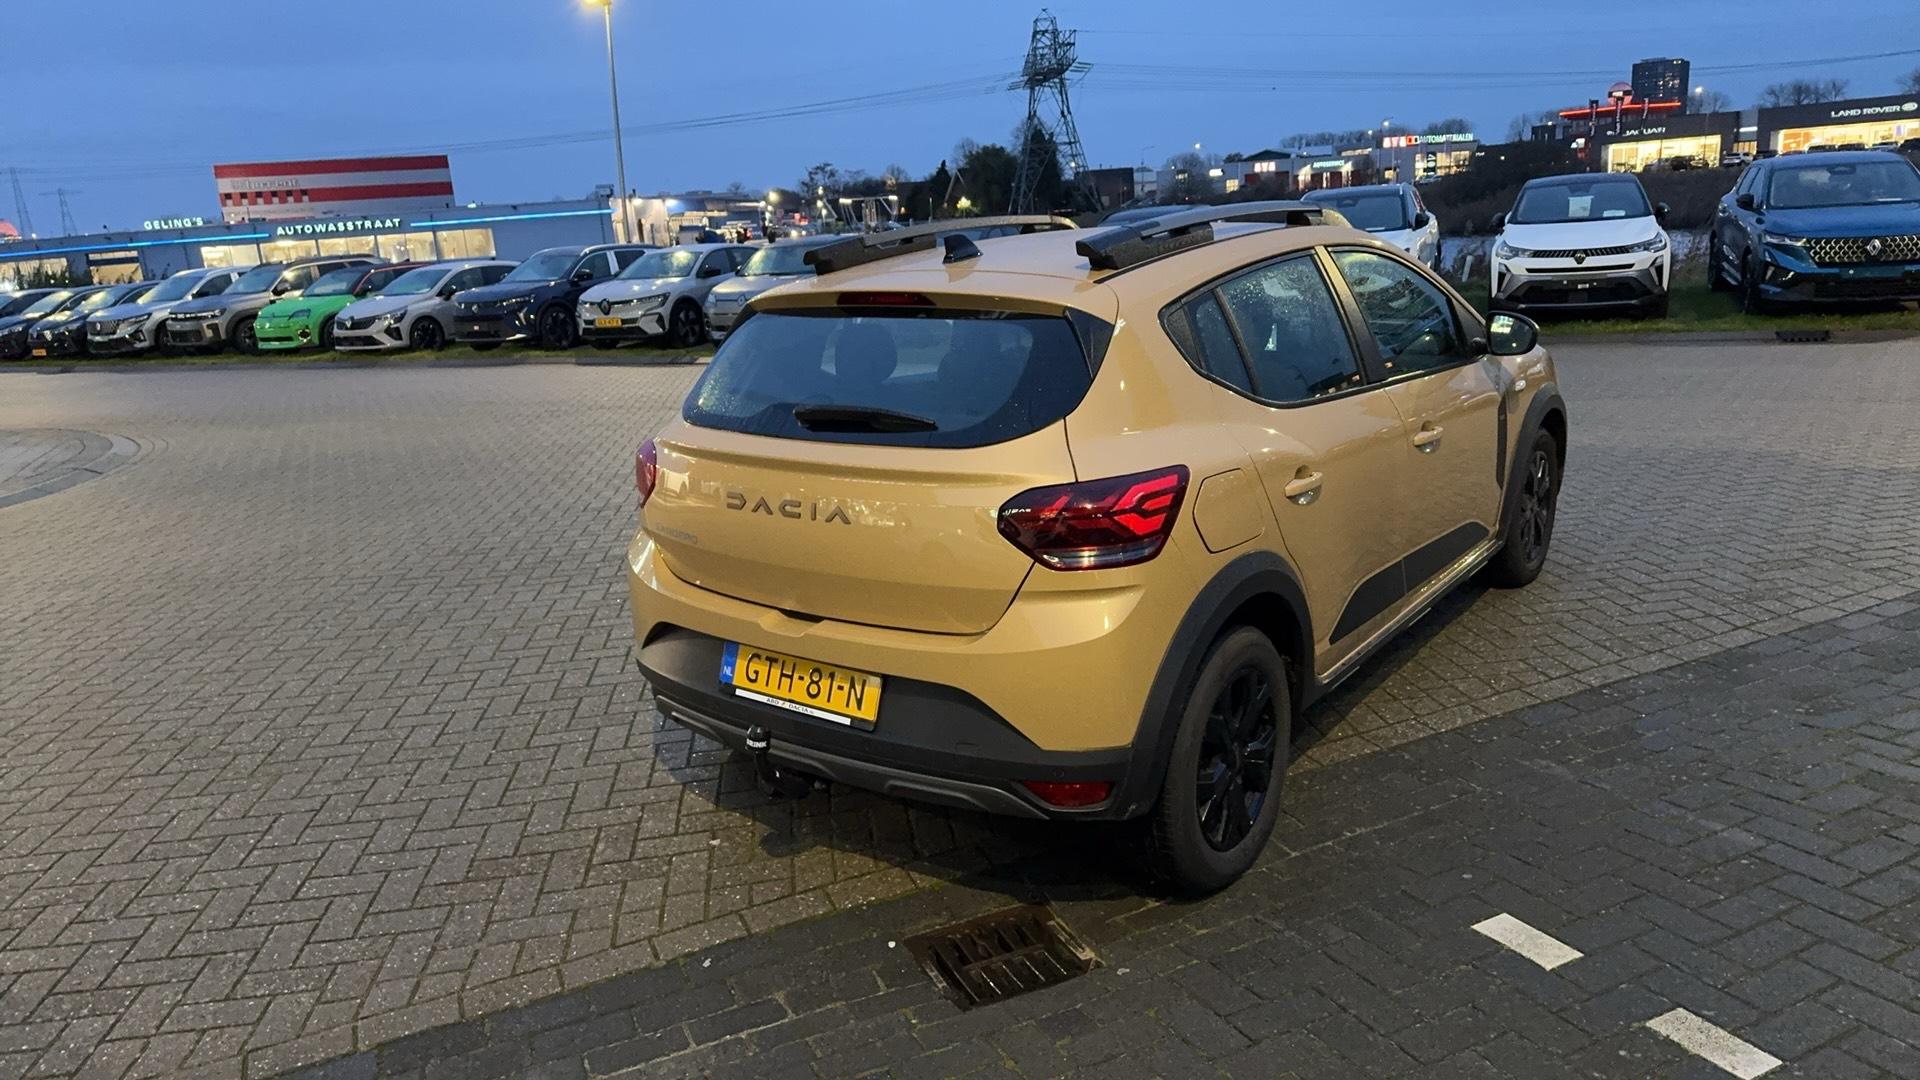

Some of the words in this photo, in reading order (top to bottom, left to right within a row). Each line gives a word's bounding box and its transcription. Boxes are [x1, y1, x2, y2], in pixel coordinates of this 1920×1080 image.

[1831, 108, 1861, 118] LAND
[1862, 105, 1901, 115] ROVER
[144, 217, 204, 230] GELING'S
[277, 218, 402, 236] AUTOWASSTRAAT
[726, 491, 851, 525] DACIA
[723, 665, 733, 676] NL
[745, 653, 867, 712] GTH-81-N
